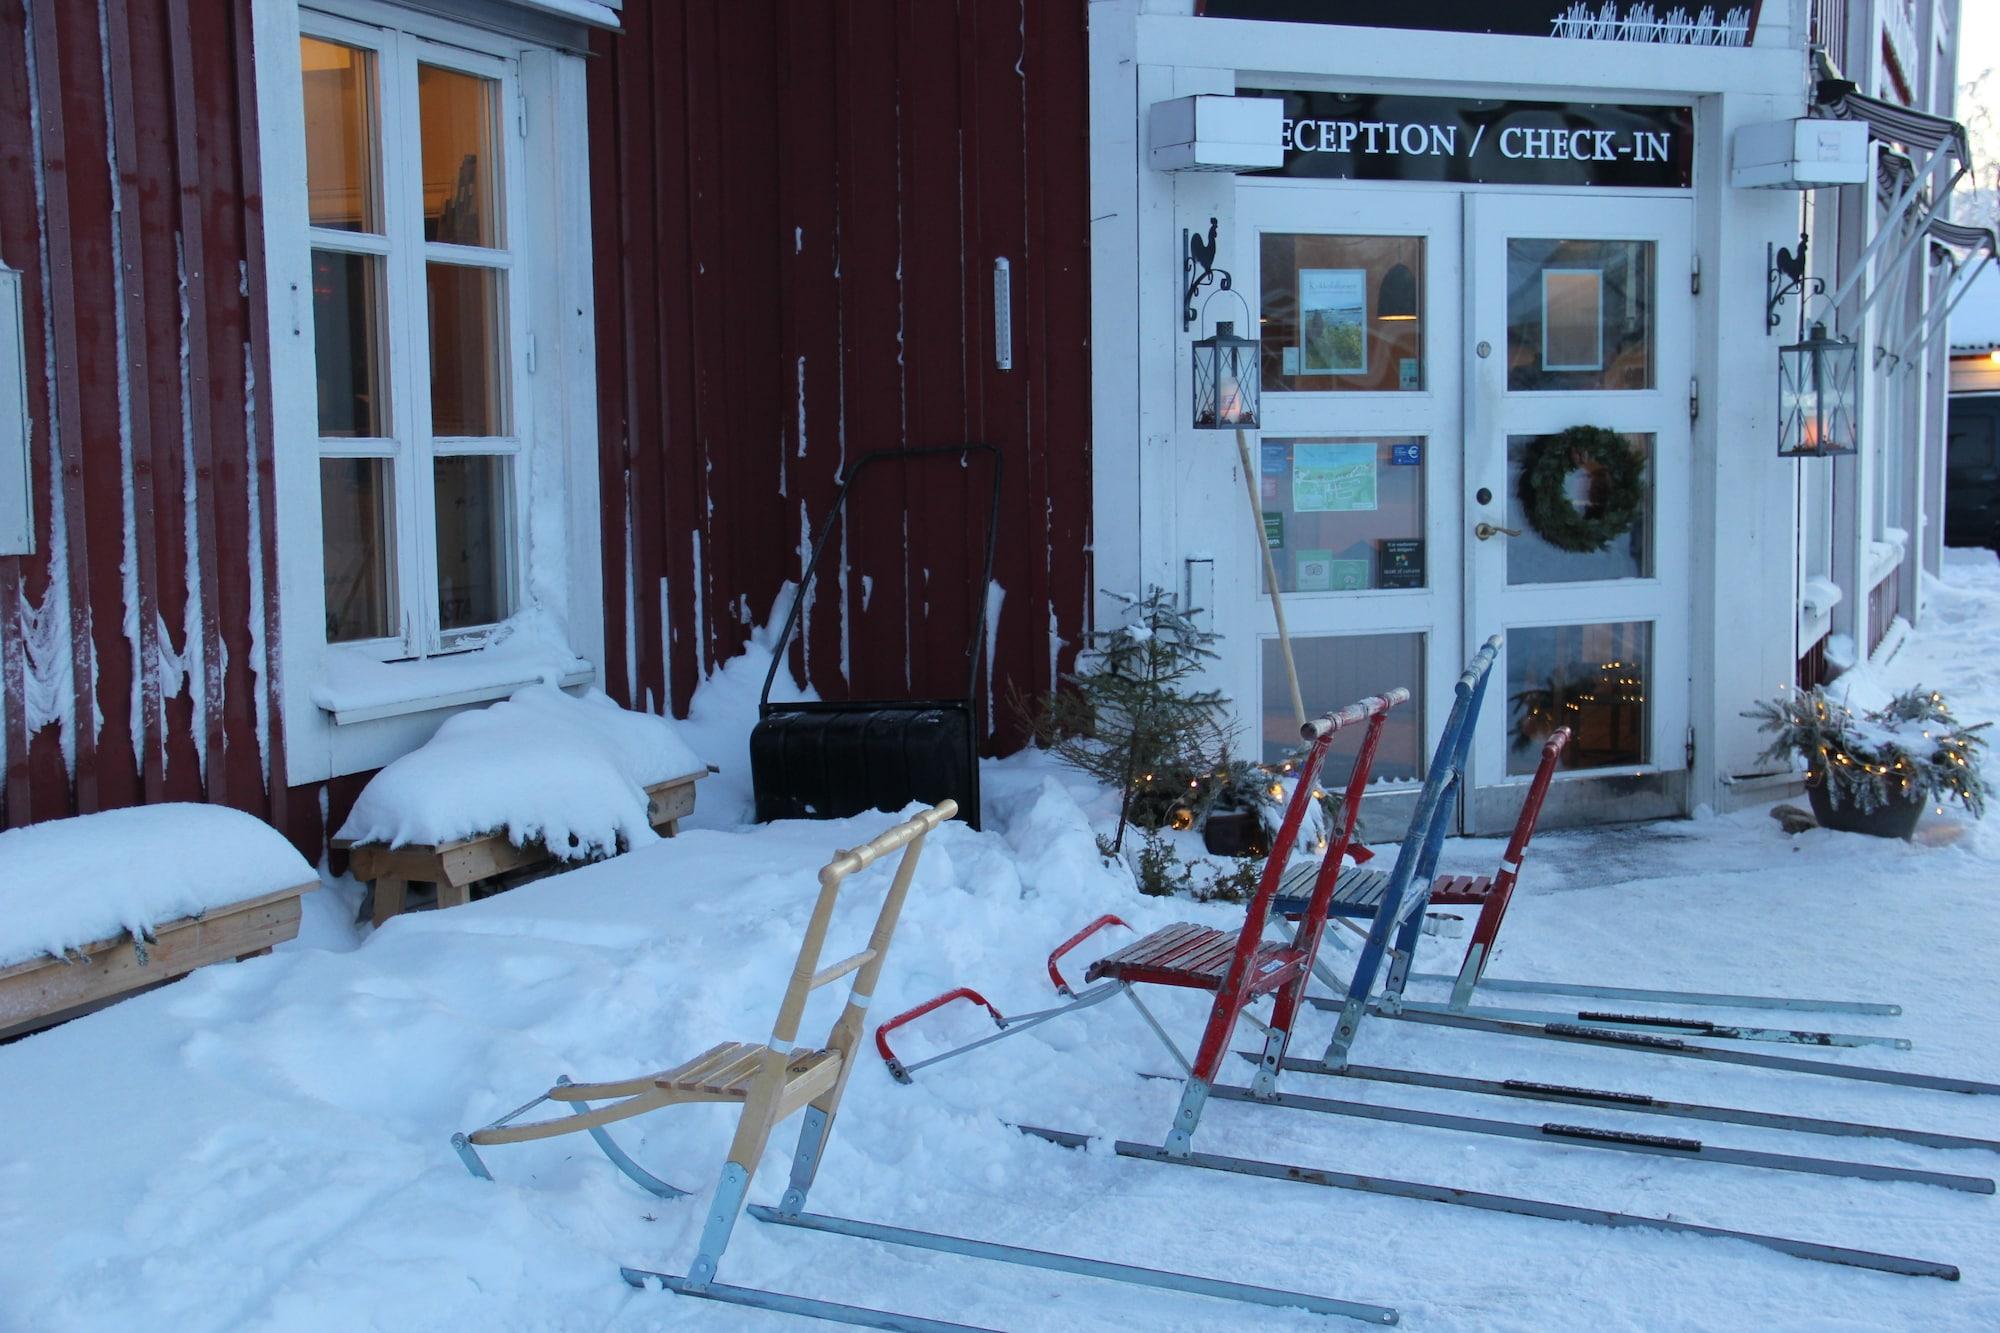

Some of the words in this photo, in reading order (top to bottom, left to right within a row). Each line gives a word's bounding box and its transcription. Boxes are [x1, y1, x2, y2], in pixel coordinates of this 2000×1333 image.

[1283, 119, 1457, 156] ECEPTION
[1468, 124, 1486, 158] /
[1500, 127, 1671, 162] CHECK-IN
